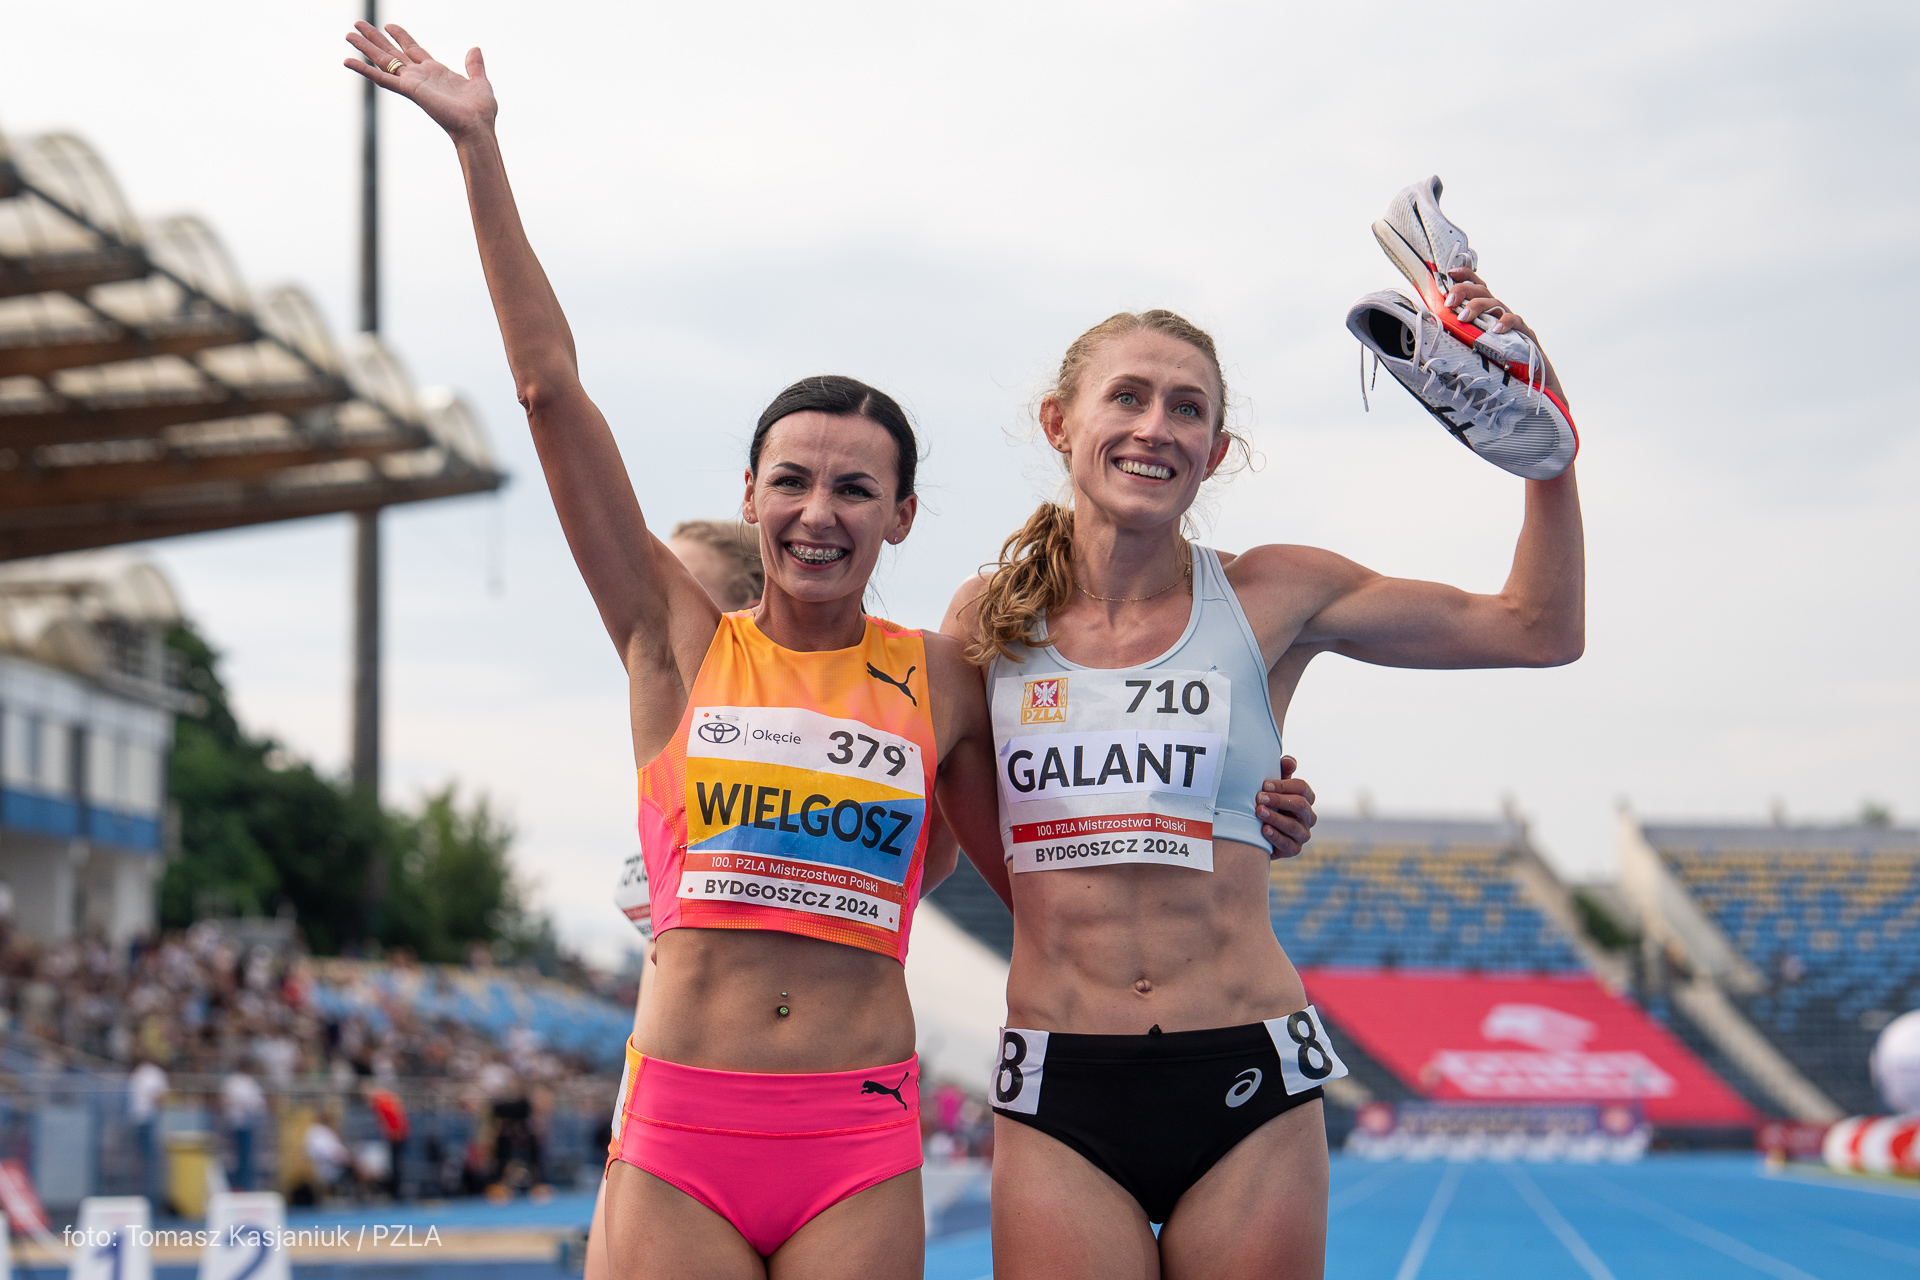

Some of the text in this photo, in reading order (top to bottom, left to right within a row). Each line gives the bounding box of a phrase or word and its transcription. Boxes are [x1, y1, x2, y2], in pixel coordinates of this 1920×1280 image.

[1023, 707, 1064, 723] PZLA
[1125, 679, 1210, 715] 710
[752, 729, 802, 746] Okęcie
[826, 730, 907, 777] 379
[1007, 743, 1207, 793] GALANT
[696, 782, 913, 857] WIELGOSZ
[1036, 817, 1186, 837] 100. PZLA Mistrzostwa Polski
[1035, 838, 1190, 863] BYDGOSZCZ 2024
[711, 856, 879, 894] 100. PZLA Mistrzostwa Polski
[705, 879, 880, 920] BYDGOSZCZ 2024
[1287, 1010, 1333, 1081] 8
[997, 1031, 1028, 1104] 8
